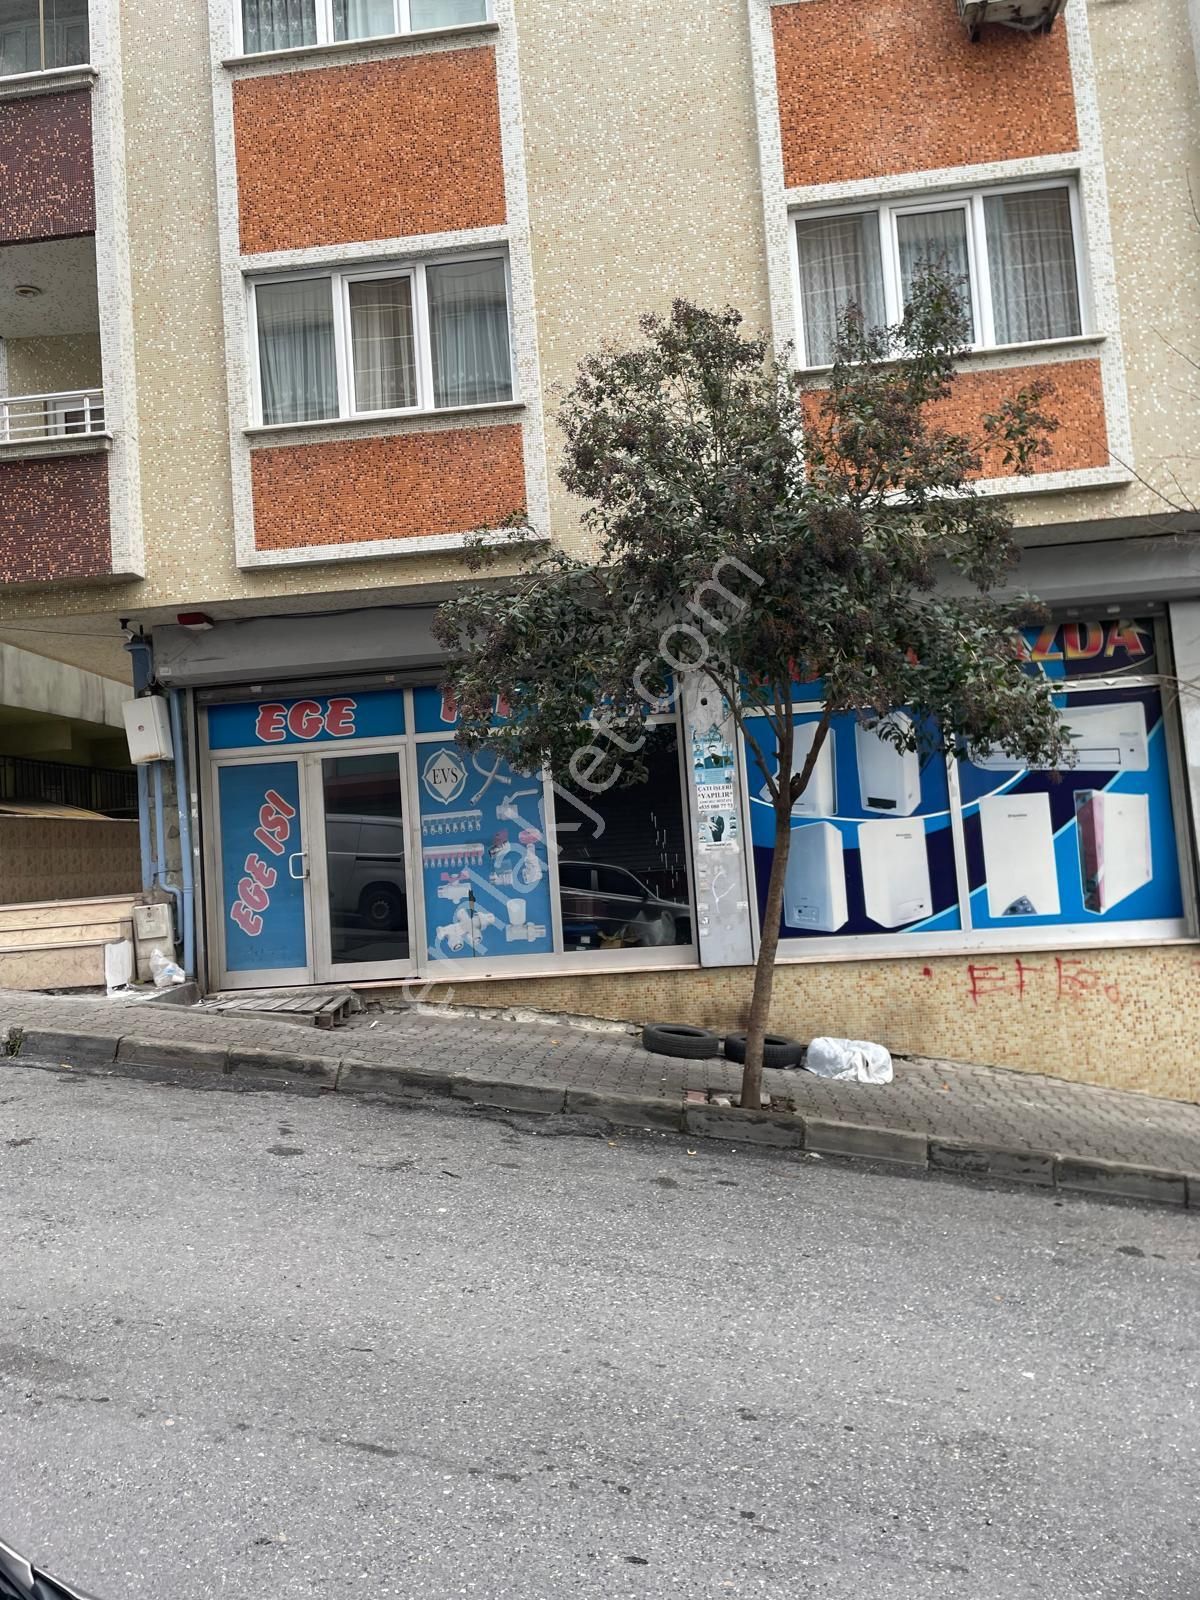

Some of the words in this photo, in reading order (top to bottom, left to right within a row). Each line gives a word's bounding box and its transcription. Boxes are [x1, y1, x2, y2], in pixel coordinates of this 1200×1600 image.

[255, 698, 358, 742] EGE
[432, 767, 459, 785] EVS
[253, 789, 297, 856] ISI
[230, 853, 278, 936] EGE
